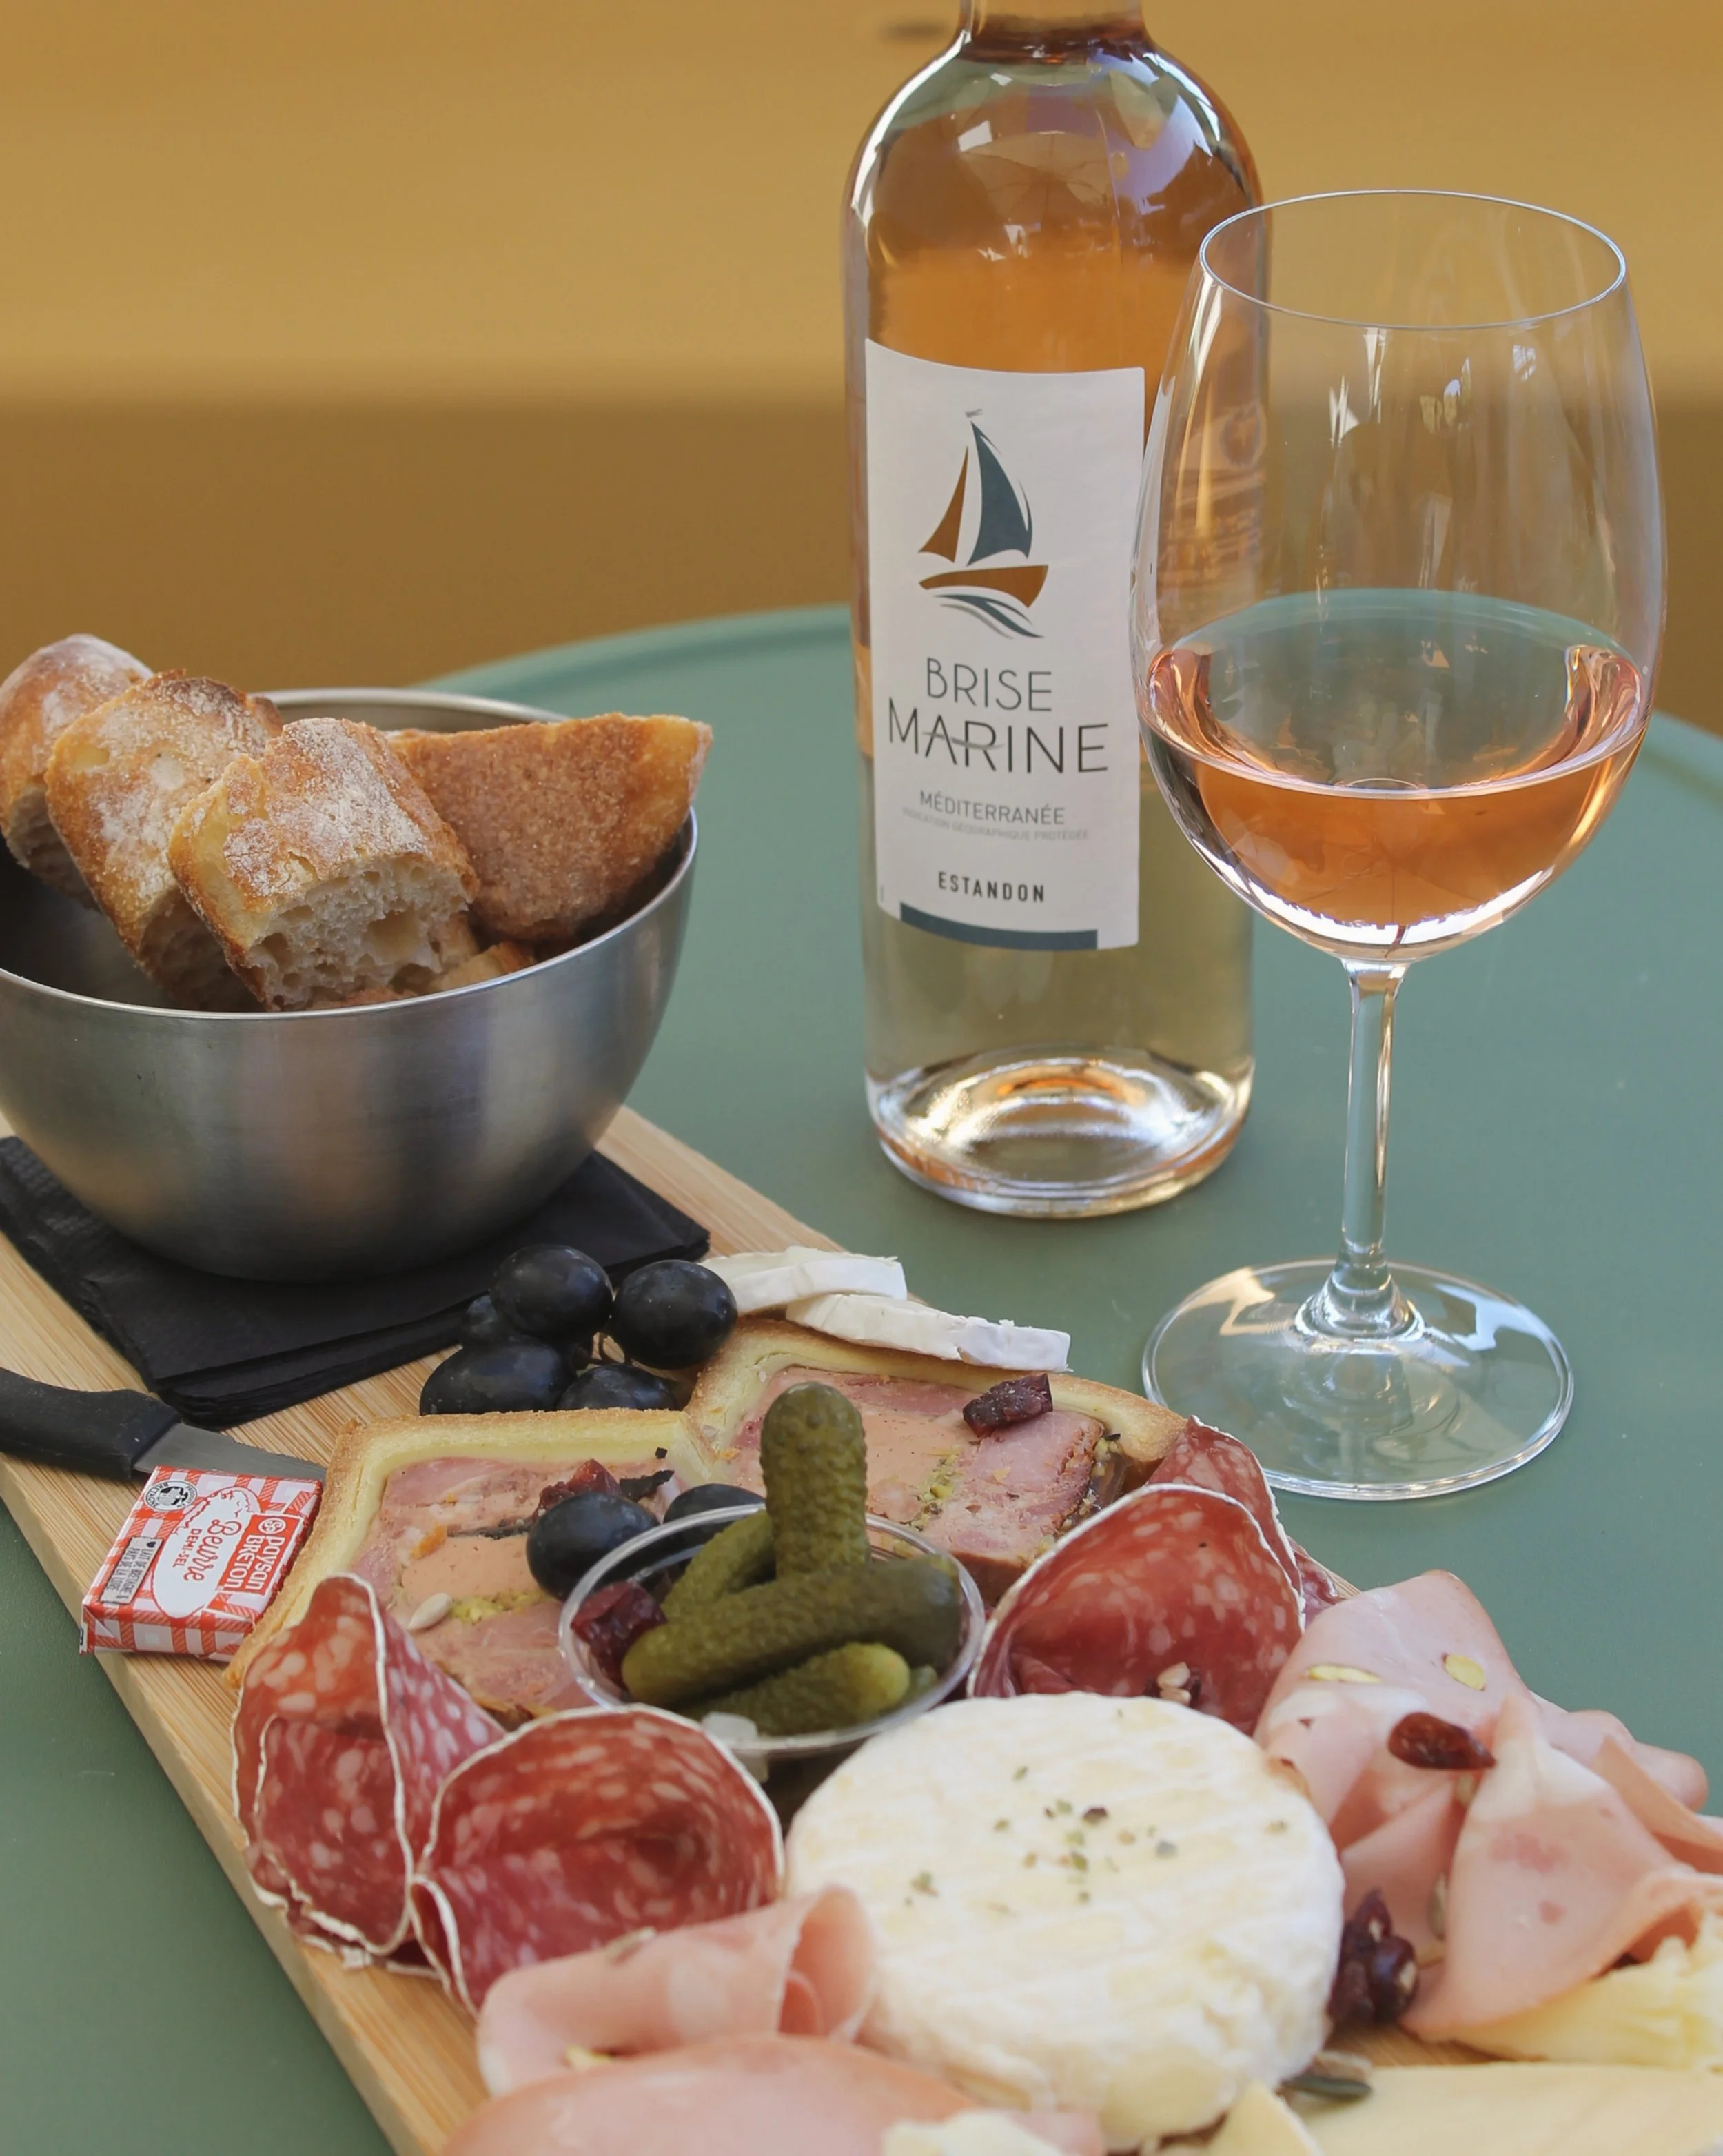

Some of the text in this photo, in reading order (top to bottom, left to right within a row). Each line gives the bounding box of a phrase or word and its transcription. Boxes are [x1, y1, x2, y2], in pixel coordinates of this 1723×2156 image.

[926, 658, 1052, 712] BRISE
[888, 696, 1108, 774] MARINE
[919, 790, 1066, 825] MÉDITERRANÉE
[938, 871, 1045, 902] ESTANDON
[147, 1482, 169, 1507] BRETAGNE
[183, 1518, 241, 1582] Beurre
